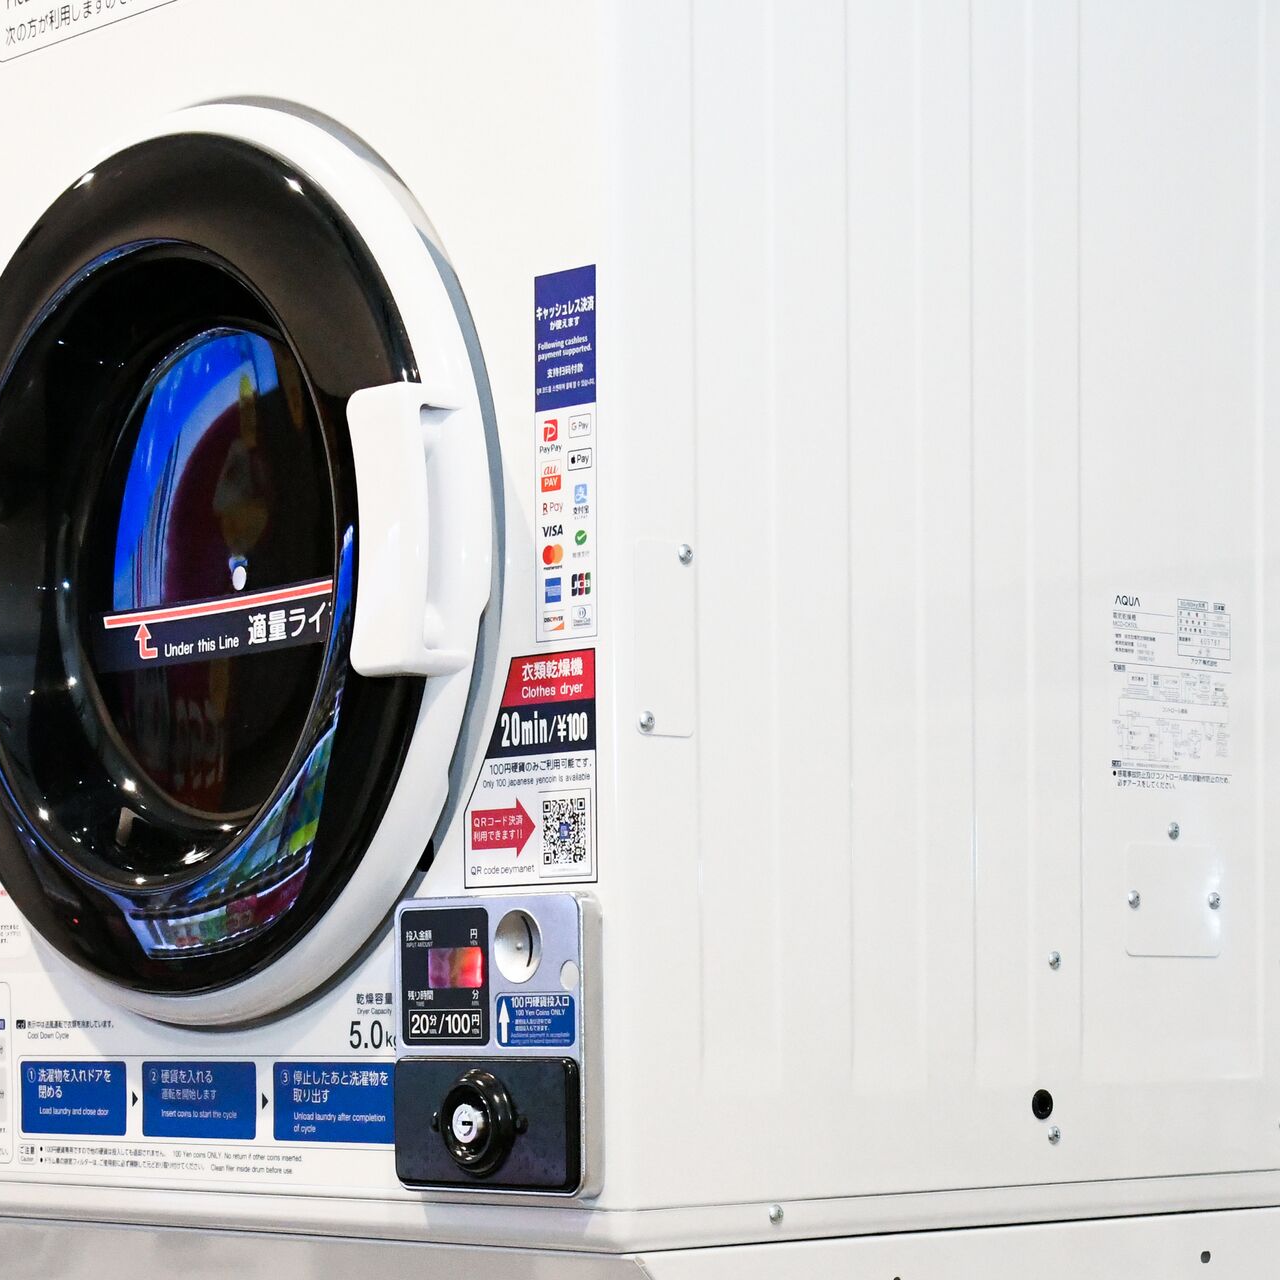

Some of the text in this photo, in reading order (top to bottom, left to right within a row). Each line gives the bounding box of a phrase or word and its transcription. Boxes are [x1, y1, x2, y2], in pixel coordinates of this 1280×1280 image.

[536, 295, 594, 321] キャッシュレス決済
[538, 335, 588, 351] Following cashless
[538, 349, 561, 362] payment
[539, 443, 562, 455] PayPay
[543, 477, 558, 488] PAY
[541, 524, 563, 537] VISA
[1115, 595, 1140, 607] AQUA
[164, 635, 239, 657] Under this Line
[521, 657, 583, 682] 衣類乾燥機
[521, 682, 583, 698] Clothes dryer
[406, 929, 478, 941] 投入金額 円
[407, 989, 479, 1001] 残り時間 分
[27, 1031, 69, 1041] Cool Down Cycle
[38, 1068, 111, 1084] 洗濯物を入れドアを
[161, 1069, 213, 1084] 硬貨を入れる
[293, 1070, 388, 1086] 停止したあと洗濯物を
[38, 1085, 63, 1099] 閉める
[161, 1088, 217, 1101] 運転を開始します
[293, 1088, 330, 1104] 取り出す
[293, 1112, 386, 1123] Unload laundry after completion
